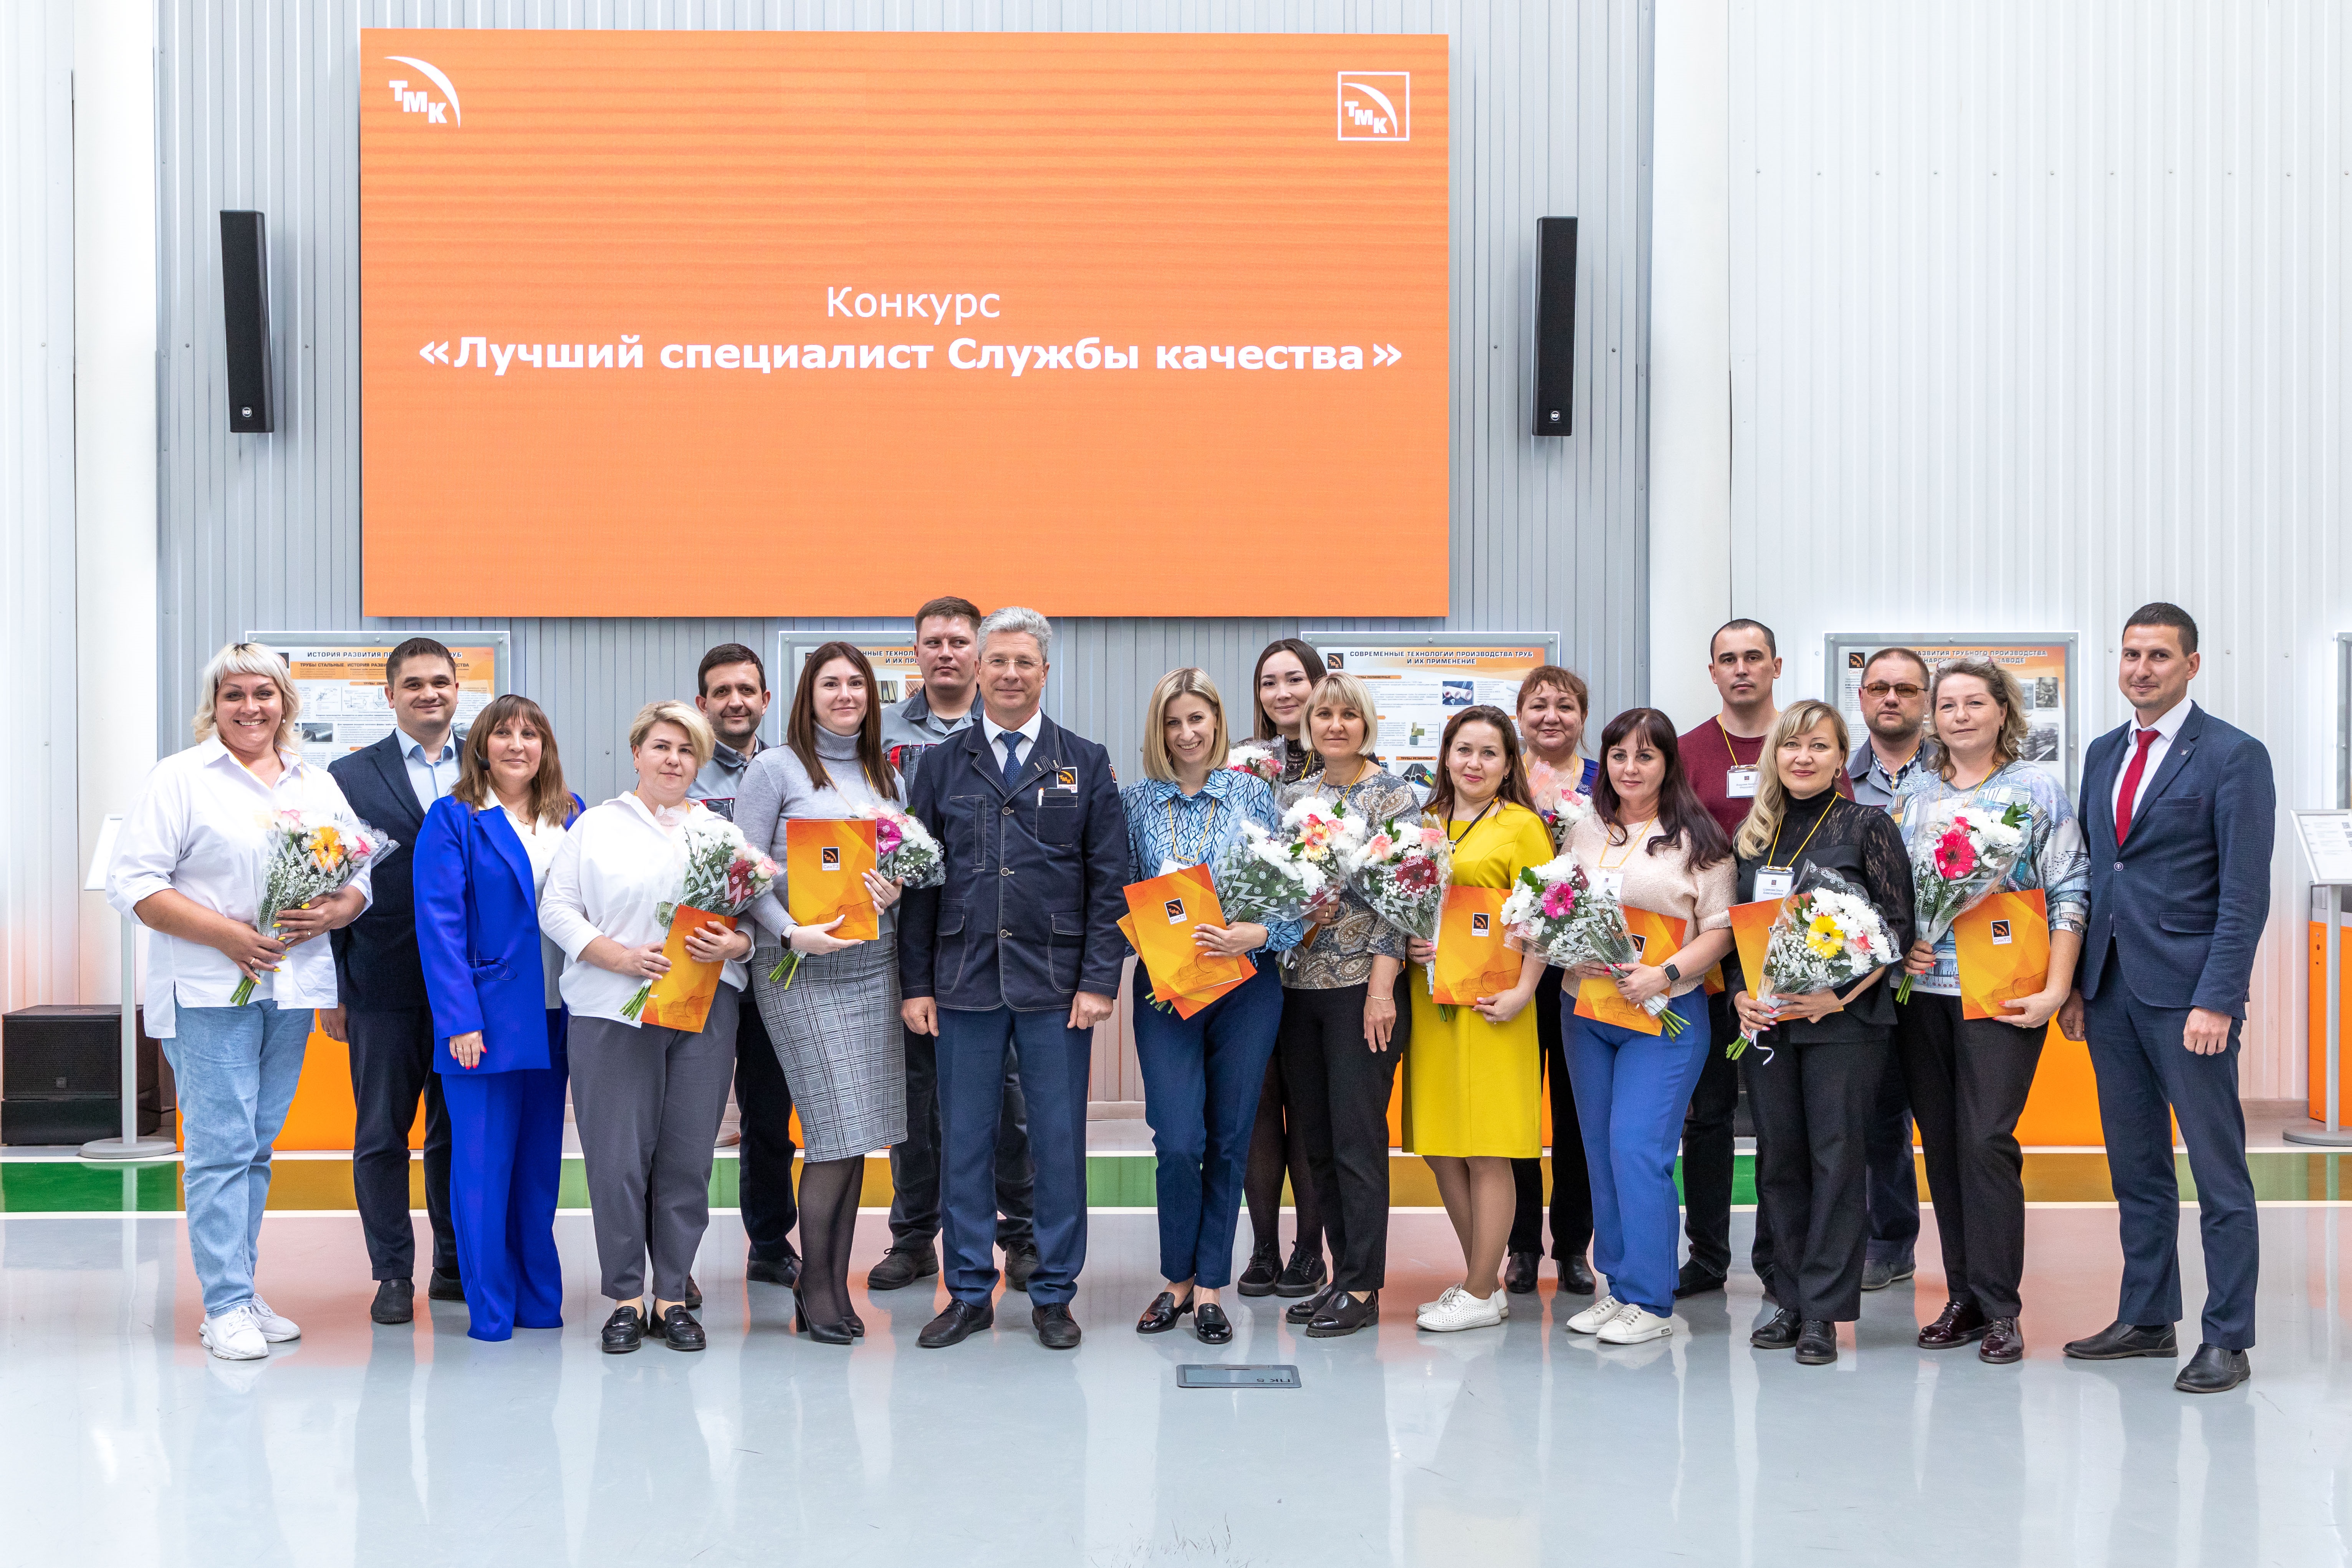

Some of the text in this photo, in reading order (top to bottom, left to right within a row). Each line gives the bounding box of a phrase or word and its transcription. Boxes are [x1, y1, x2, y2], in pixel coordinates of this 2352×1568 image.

[389, 80, 447, 123] ТМК
[1344, 101, 1387, 133] ТМК
[827, 286, 1000, 325] Конкурс
[419, 334, 644, 376] «Лучший
[660, 344, 934, 374] специалист
[947, 336, 1139, 377] Службы
[1059, 775, 1071, 784] ТМК
[824, 854, 834, 863] ТМК
[1475, 920, 1484, 928] ТМК
